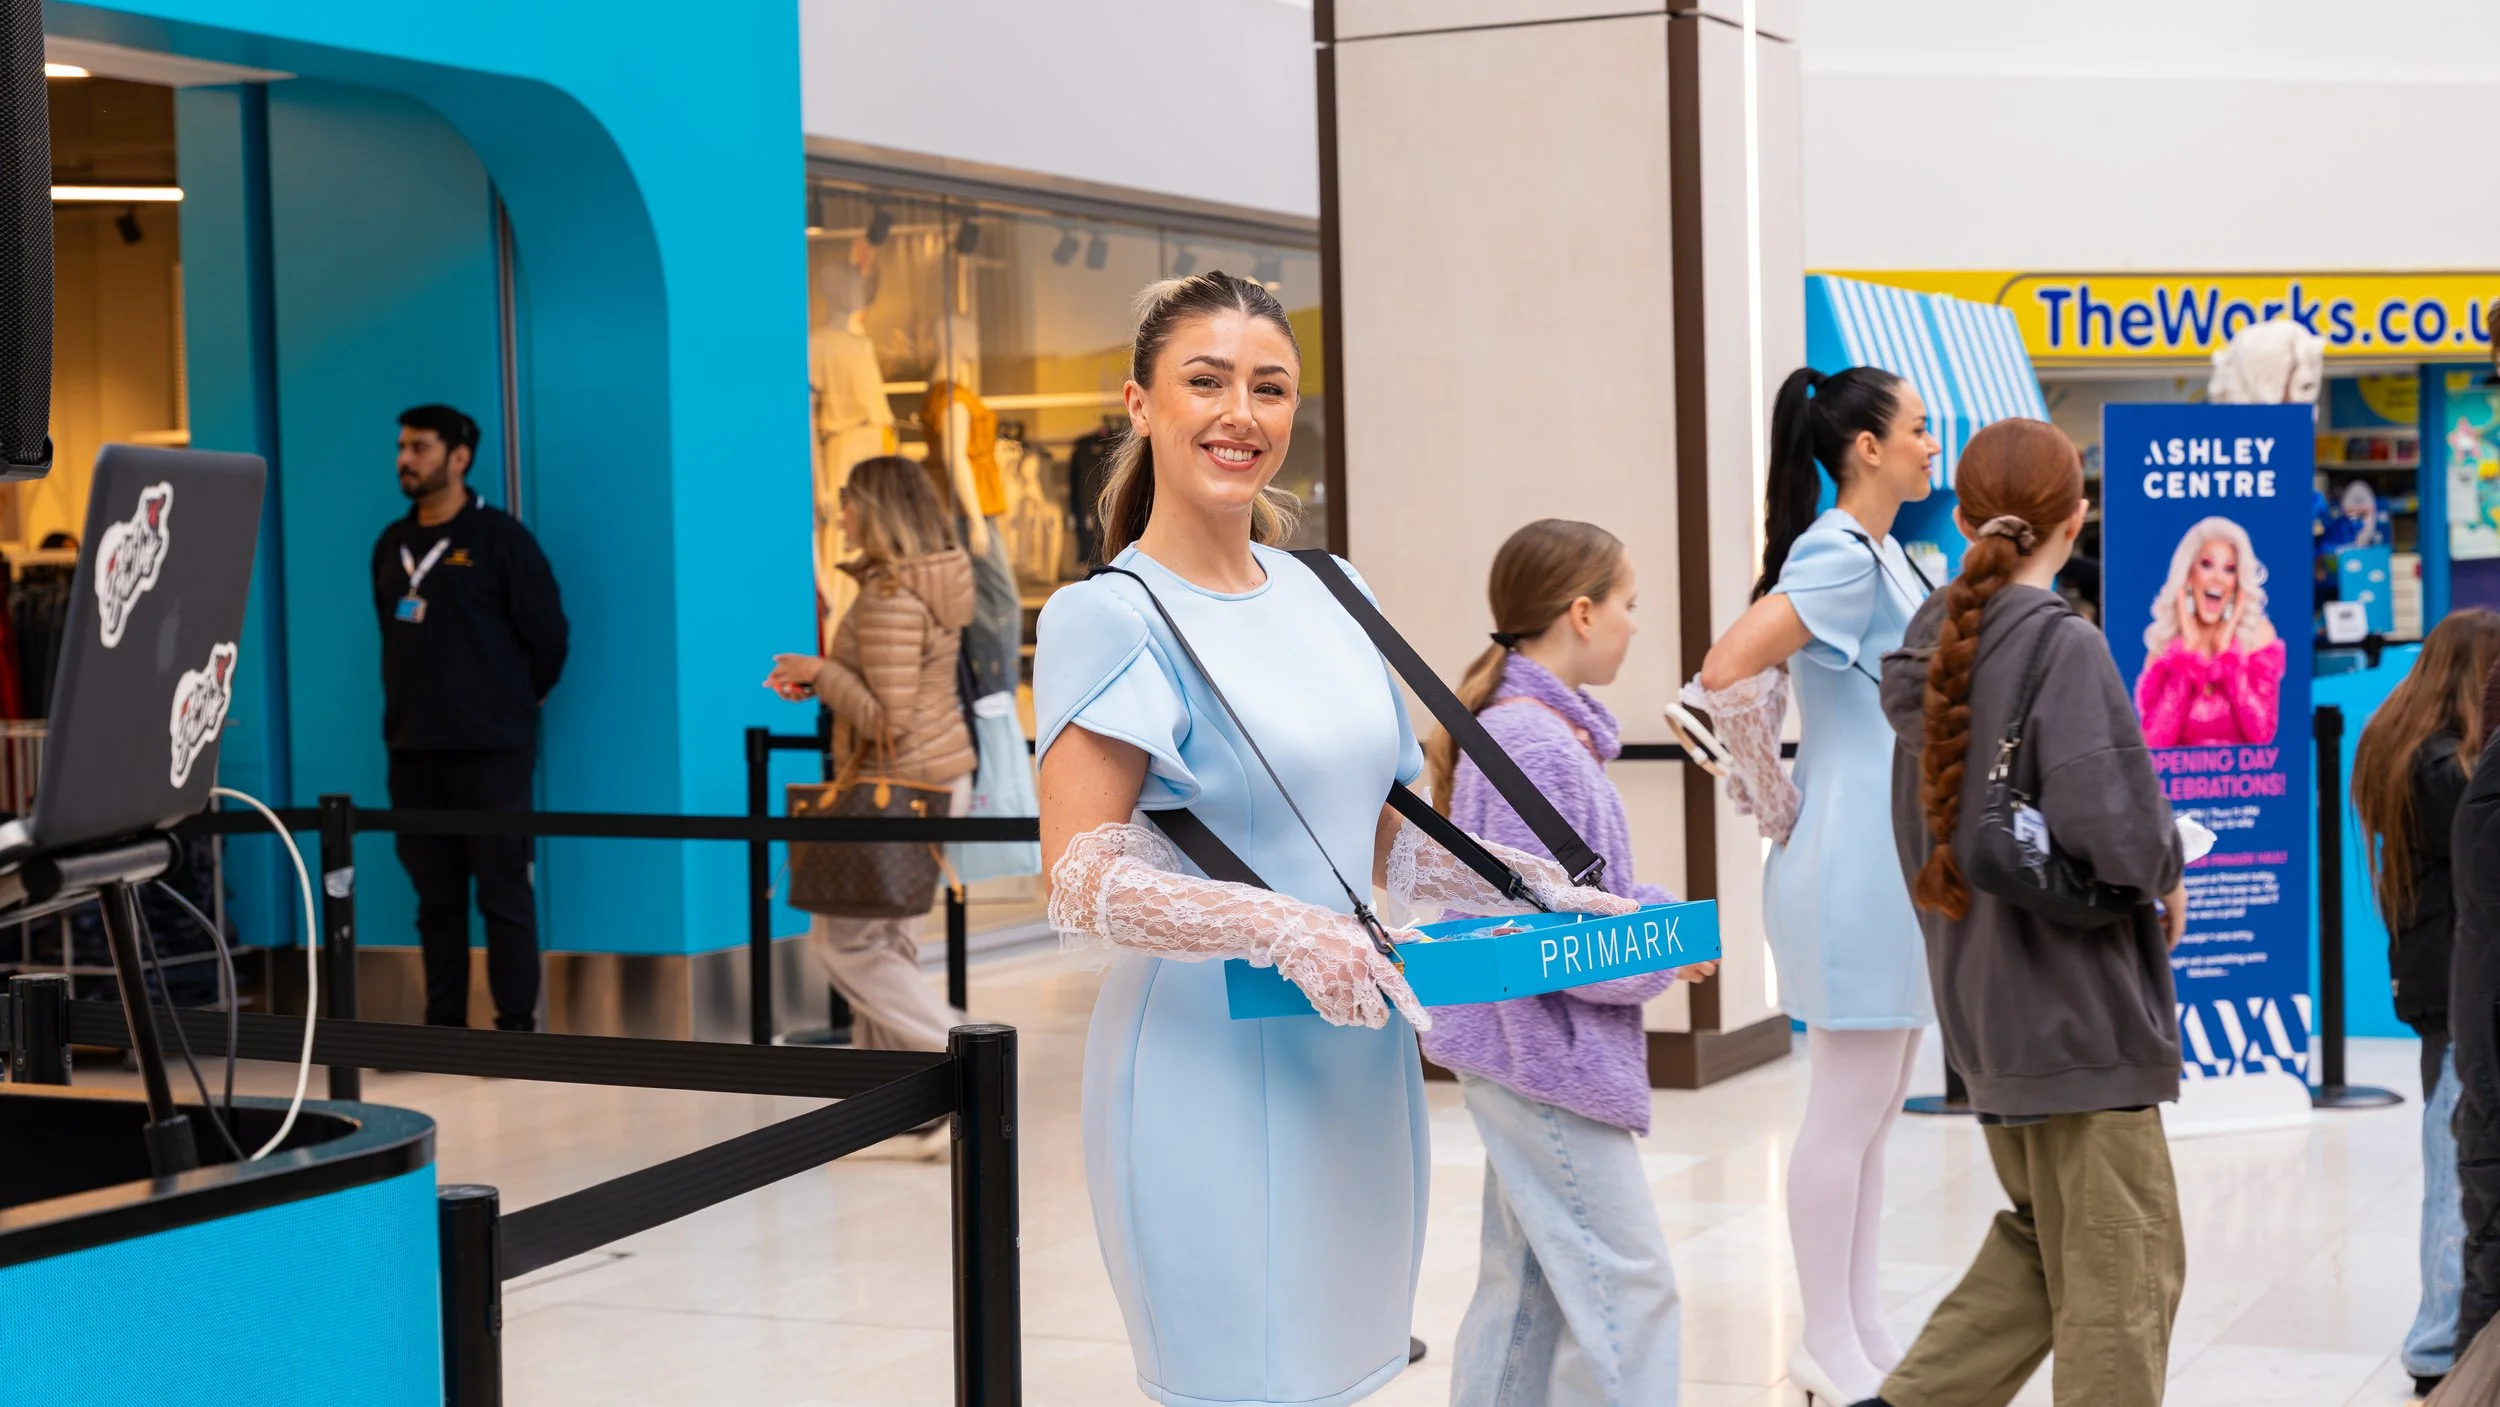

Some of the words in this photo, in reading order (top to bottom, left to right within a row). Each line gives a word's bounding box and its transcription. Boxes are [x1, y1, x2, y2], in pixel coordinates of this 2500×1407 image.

[2144, 437, 2276, 466] ASHLEY
[2143, 470, 2276, 499] CENTRE
[2238, 746, 2280, 771] DAY
[2160, 772, 2287, 800] LEBRATIONS!
[1540, 916, 1684, 979] PRIMARK
